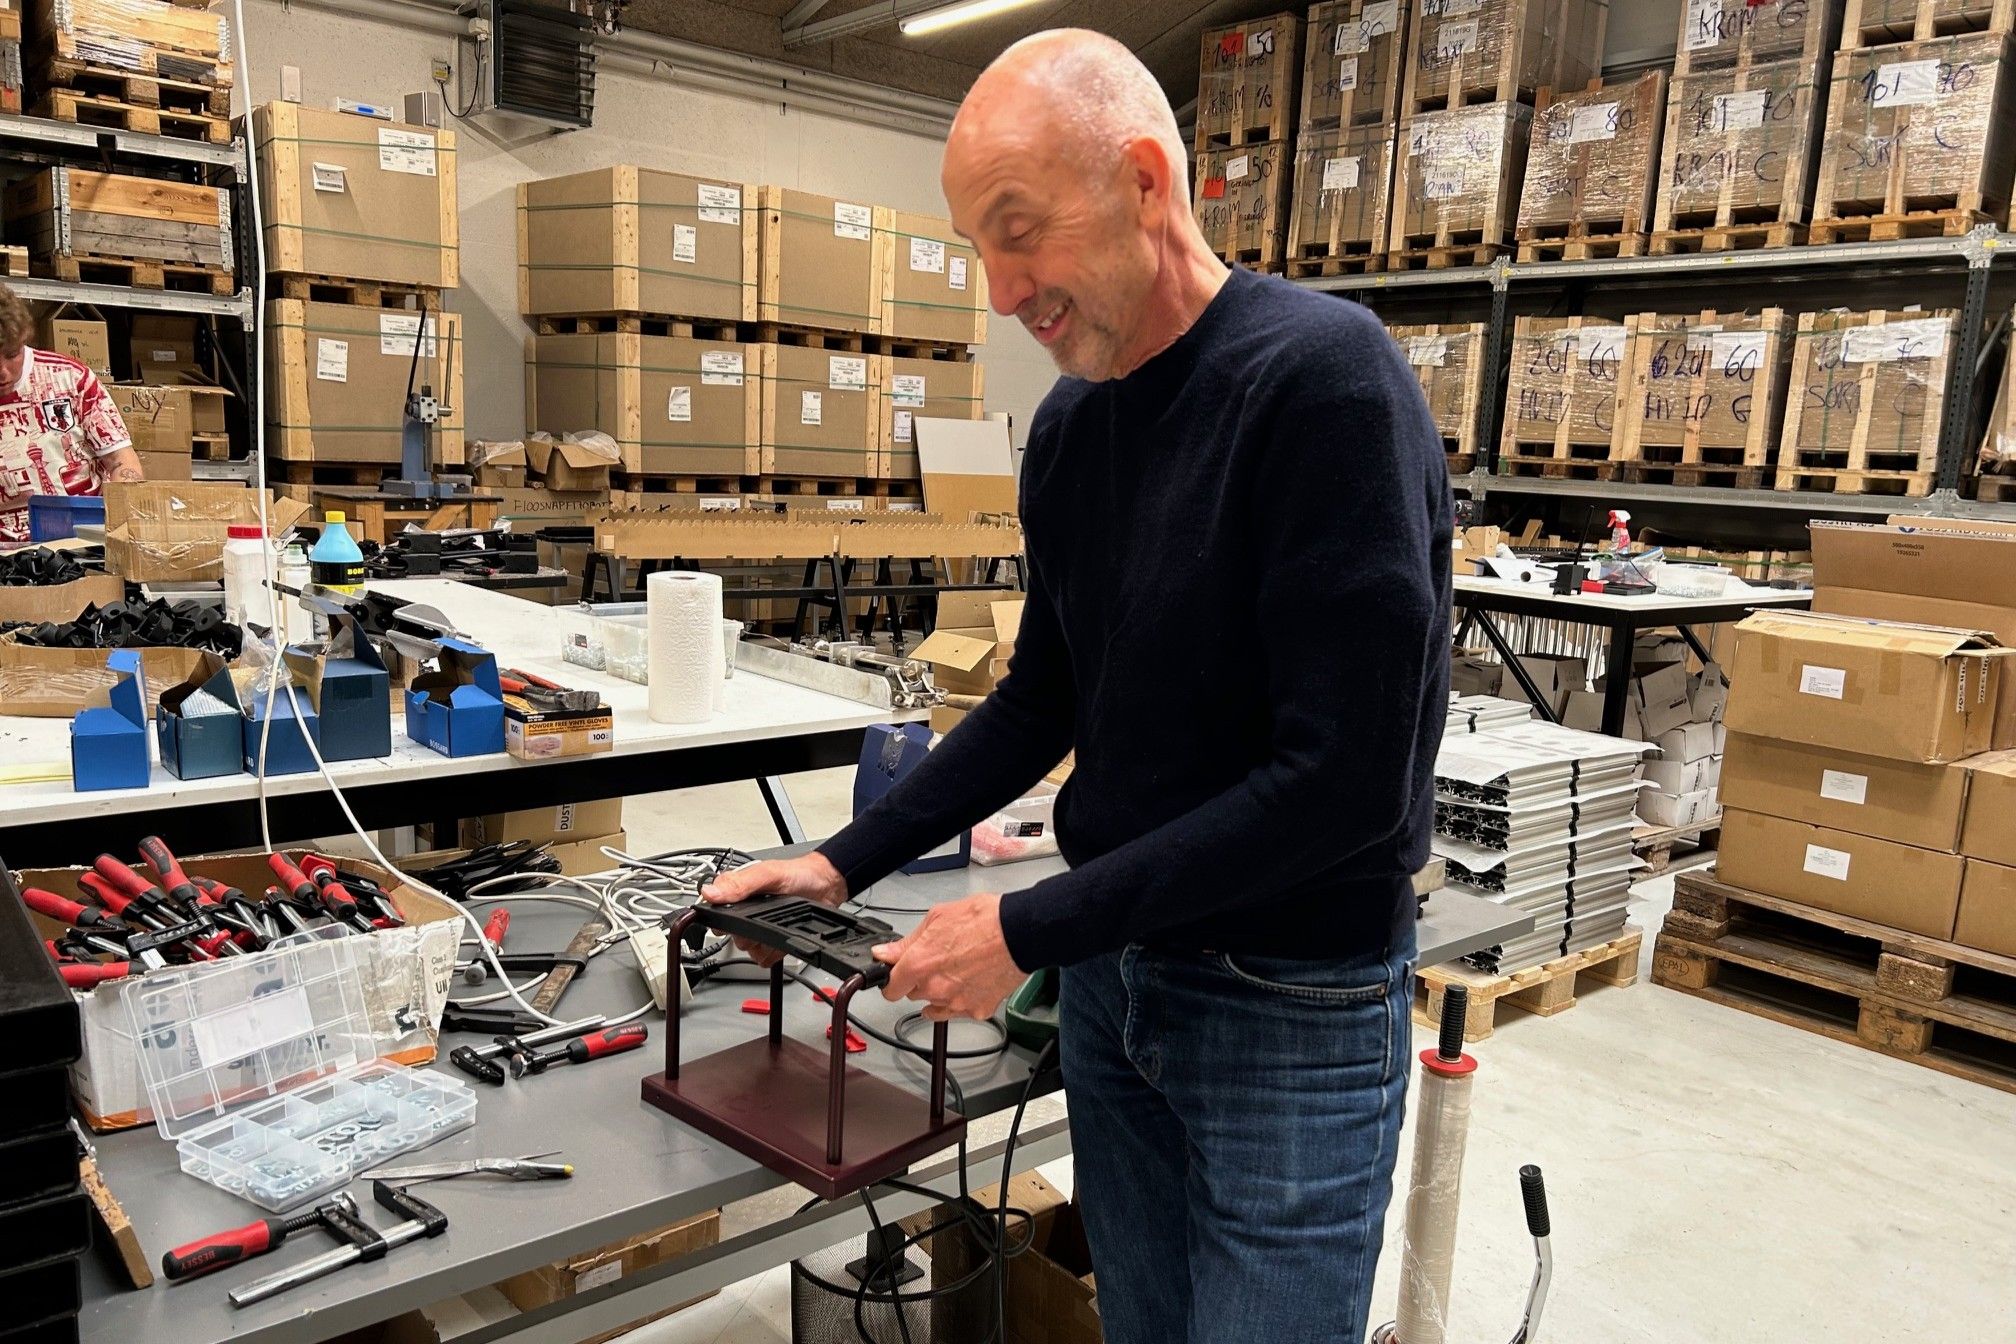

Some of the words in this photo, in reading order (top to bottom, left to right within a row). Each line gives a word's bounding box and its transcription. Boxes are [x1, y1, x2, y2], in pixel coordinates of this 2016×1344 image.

[1861, 69, 1901, 102] 101
[1935, 63, 1974, 94] 70
[1605, 106, 1632, 132] 80
[1761, 90, 1795, 122] 70
[1252, 155, 1273, 183] 50
[1753, 151, 1779, 182] C
[1588, 340, 1618, 381] 60
[1723, 345, 1758, 382] 60
[1644, 391, 1713, 421] HVID
[1732, 395, 1753, 423] G
